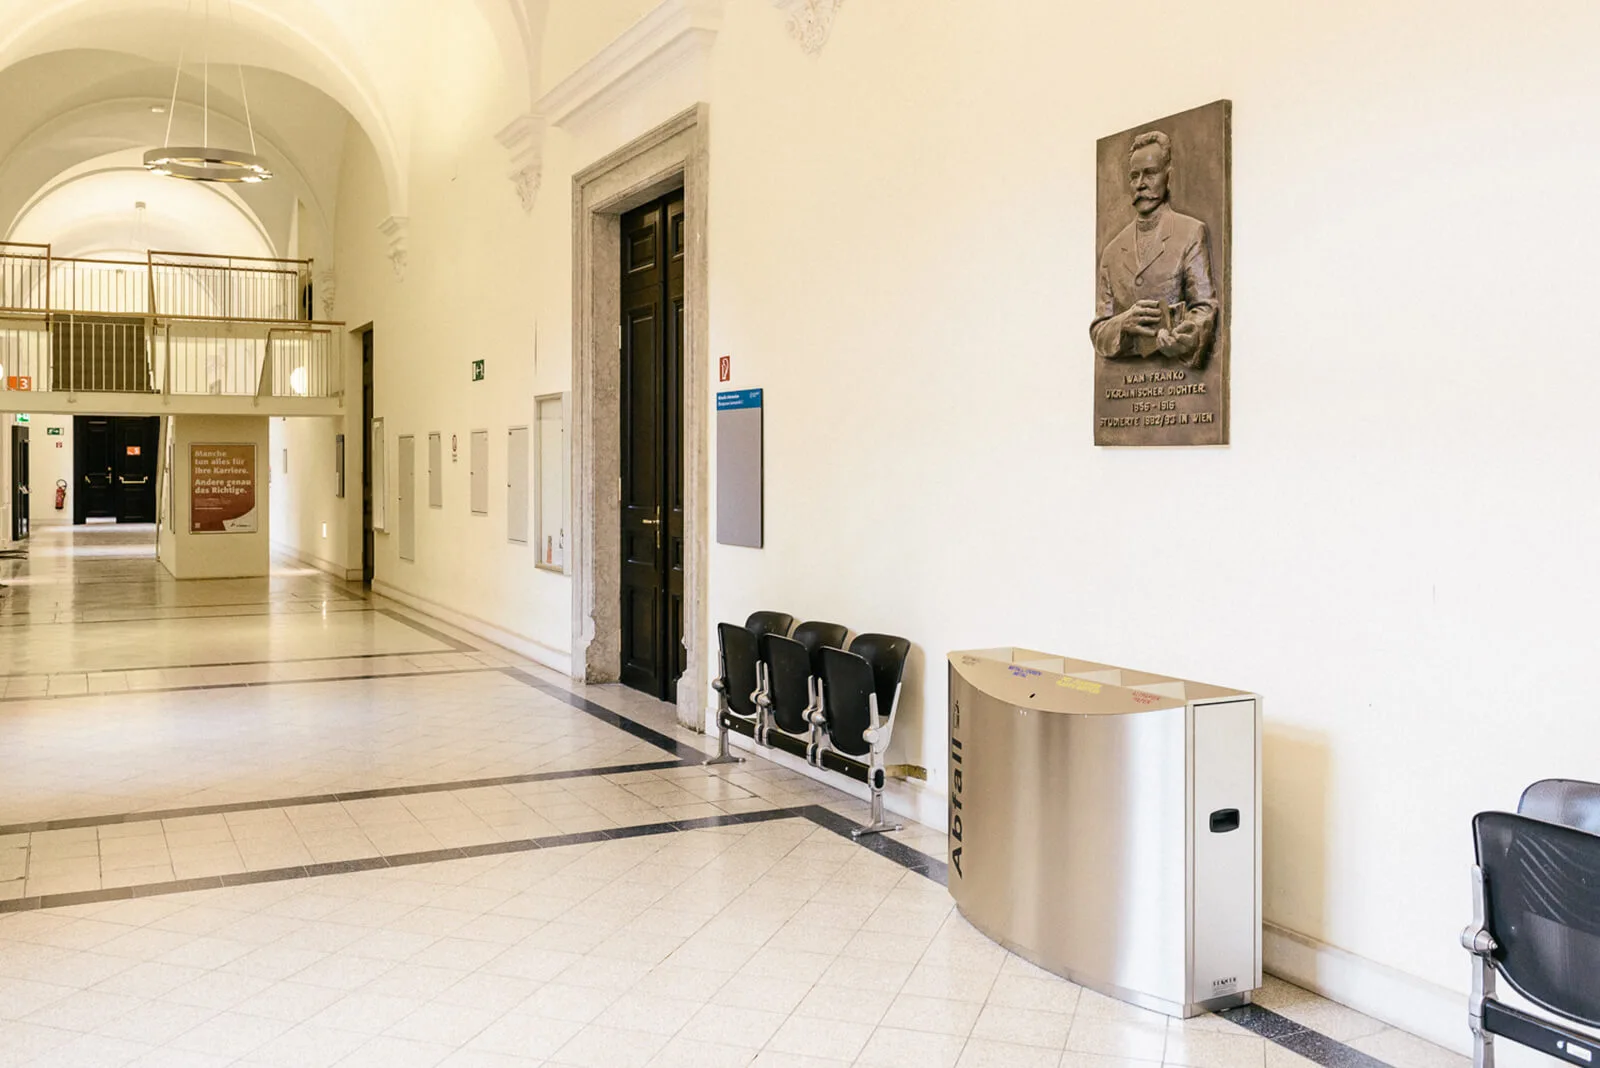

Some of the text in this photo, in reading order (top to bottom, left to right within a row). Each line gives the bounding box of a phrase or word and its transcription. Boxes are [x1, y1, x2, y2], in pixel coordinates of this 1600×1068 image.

[1123, 370, 1185, 384] IWAN FRANKO
[20, 378, 28, 389] 3
[1168, 382, 1206, 395] DICHTER
[1100, 416, 1140, 427] STUDIERTE
[1179, 413, 1189, 424] IN
[1193, 411, 1214, 424] WIEN
[213, 466, 249, 474] Karriere.
[195, 478, 252, 488] Andere genau
[195, 486, 248, 495] das Richtige.
[952, 737, 963, 881] Abfall
